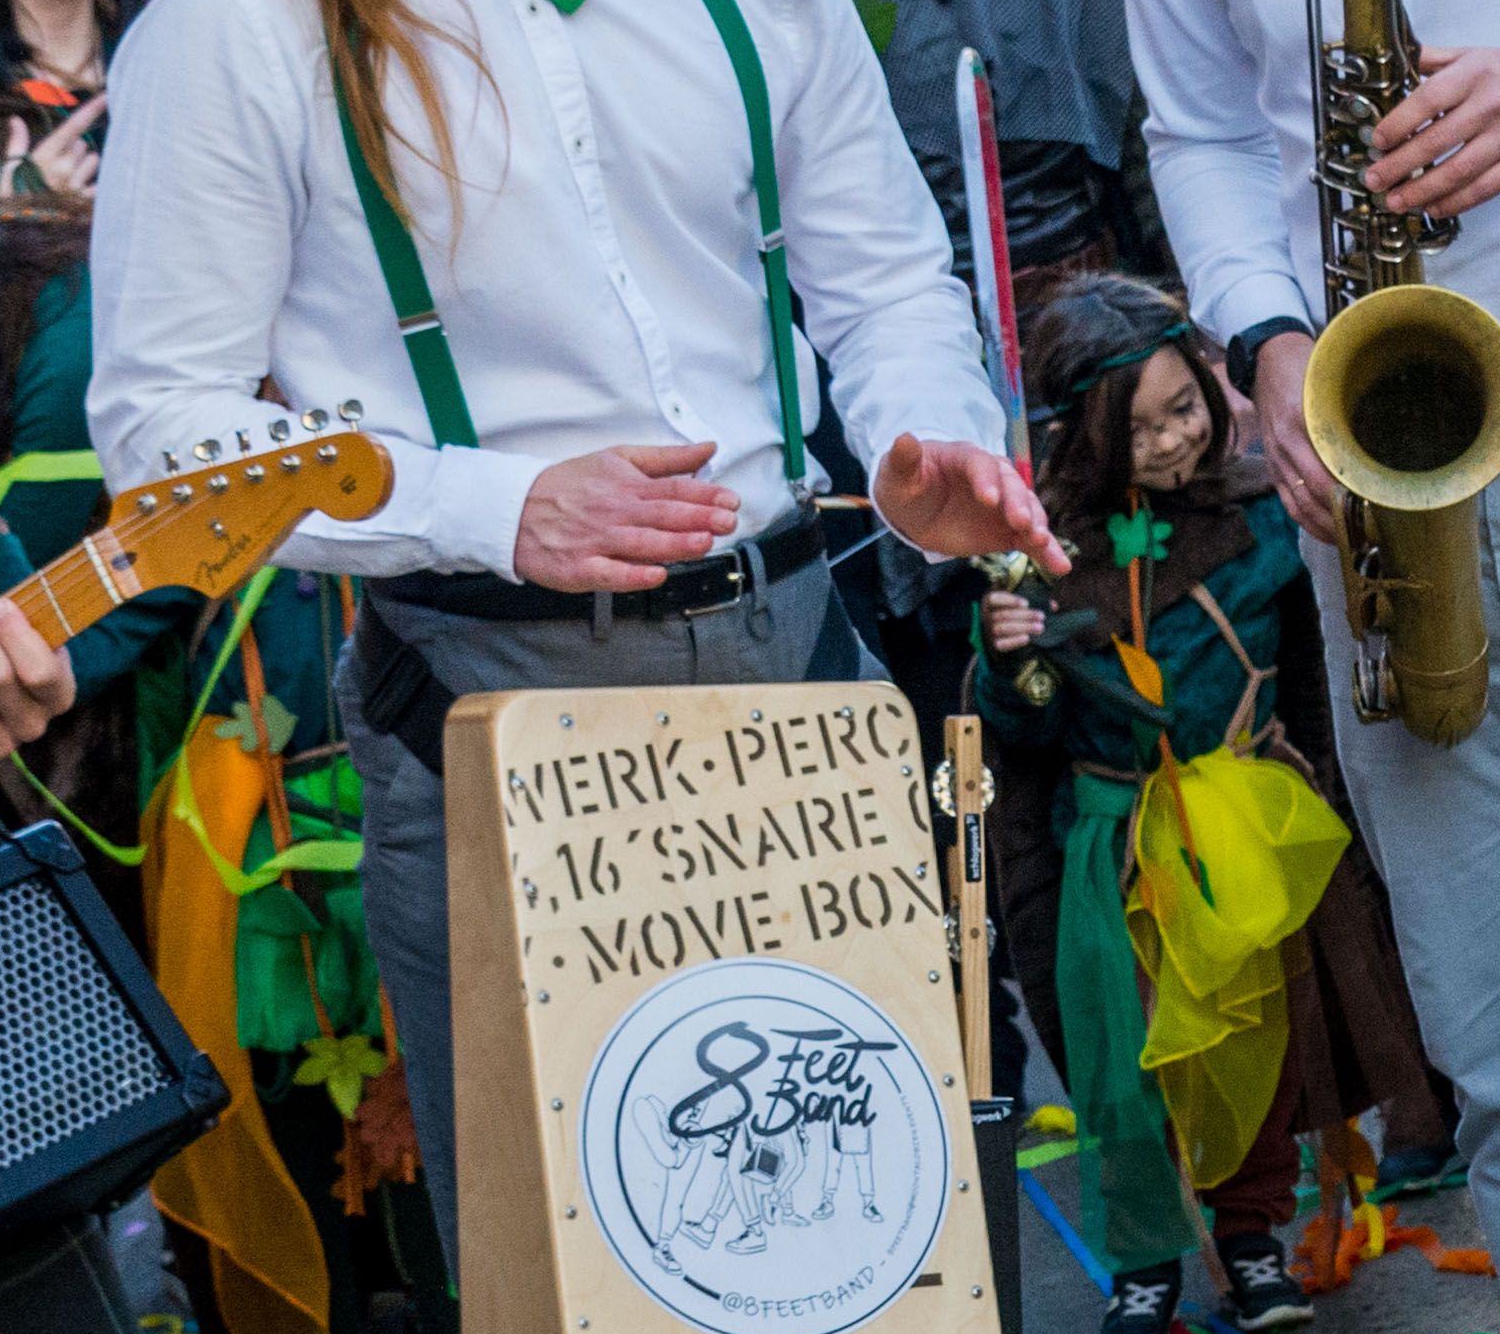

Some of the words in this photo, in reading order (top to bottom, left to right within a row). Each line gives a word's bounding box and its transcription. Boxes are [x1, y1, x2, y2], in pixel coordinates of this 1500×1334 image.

[582, 891, 782, 983] MOVE
[801, 861, 940, 942] BOX
[668, 1020, 771, 1137] 8
[769, 1028, 898, 1092] Feet
[750, 1078, 878, 1137] Band
[721, 1264, 878, 1320] @8FEETBAND
